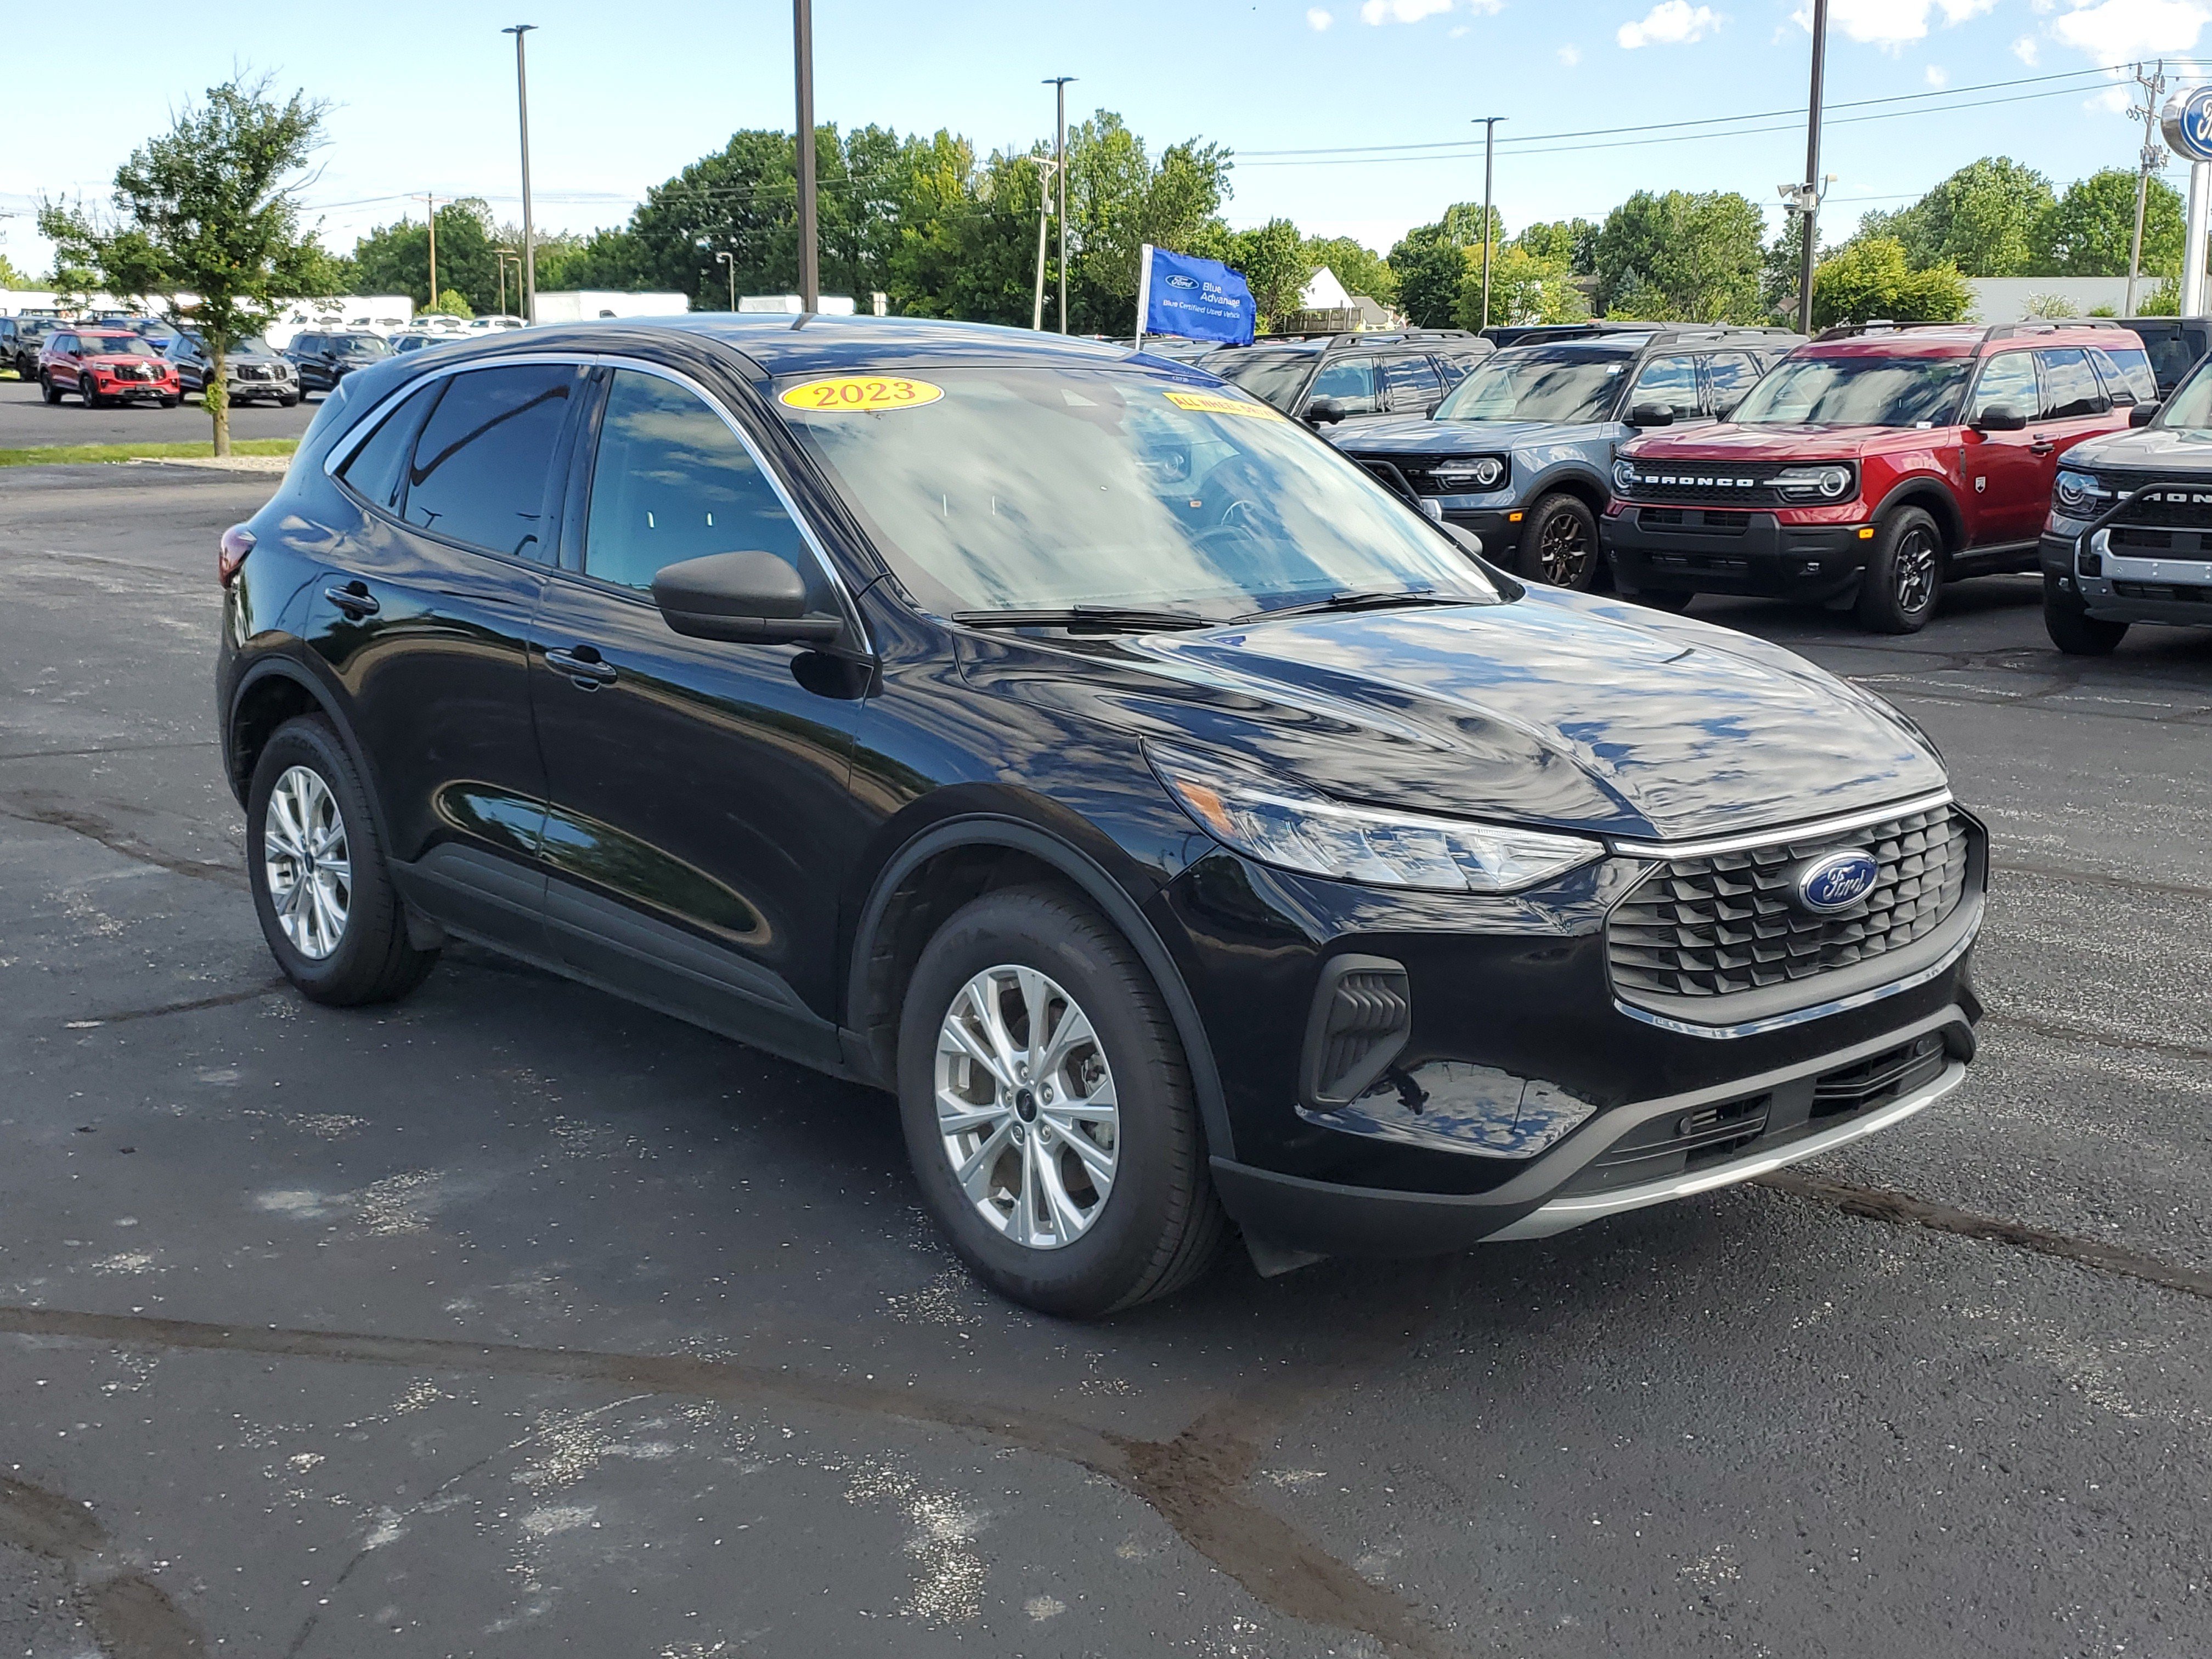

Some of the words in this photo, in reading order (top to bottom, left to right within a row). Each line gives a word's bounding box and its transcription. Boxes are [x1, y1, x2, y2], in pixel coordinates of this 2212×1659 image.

[1171, 276, 1193, 287] Ford
[1203, 282, 1222, 293] Blue
[1200, 292, 1240, 308] Advanage
[1179, 302, 1205, 313] Certified
[1207, 308, 1222, 317] Used
[813, 382, 916, 406] 2023
[1174, 397, 1200, 407] ALL
[1645, 476, 1754, 487] BRONCO
[1823, 865, 1865, 901] Ford
